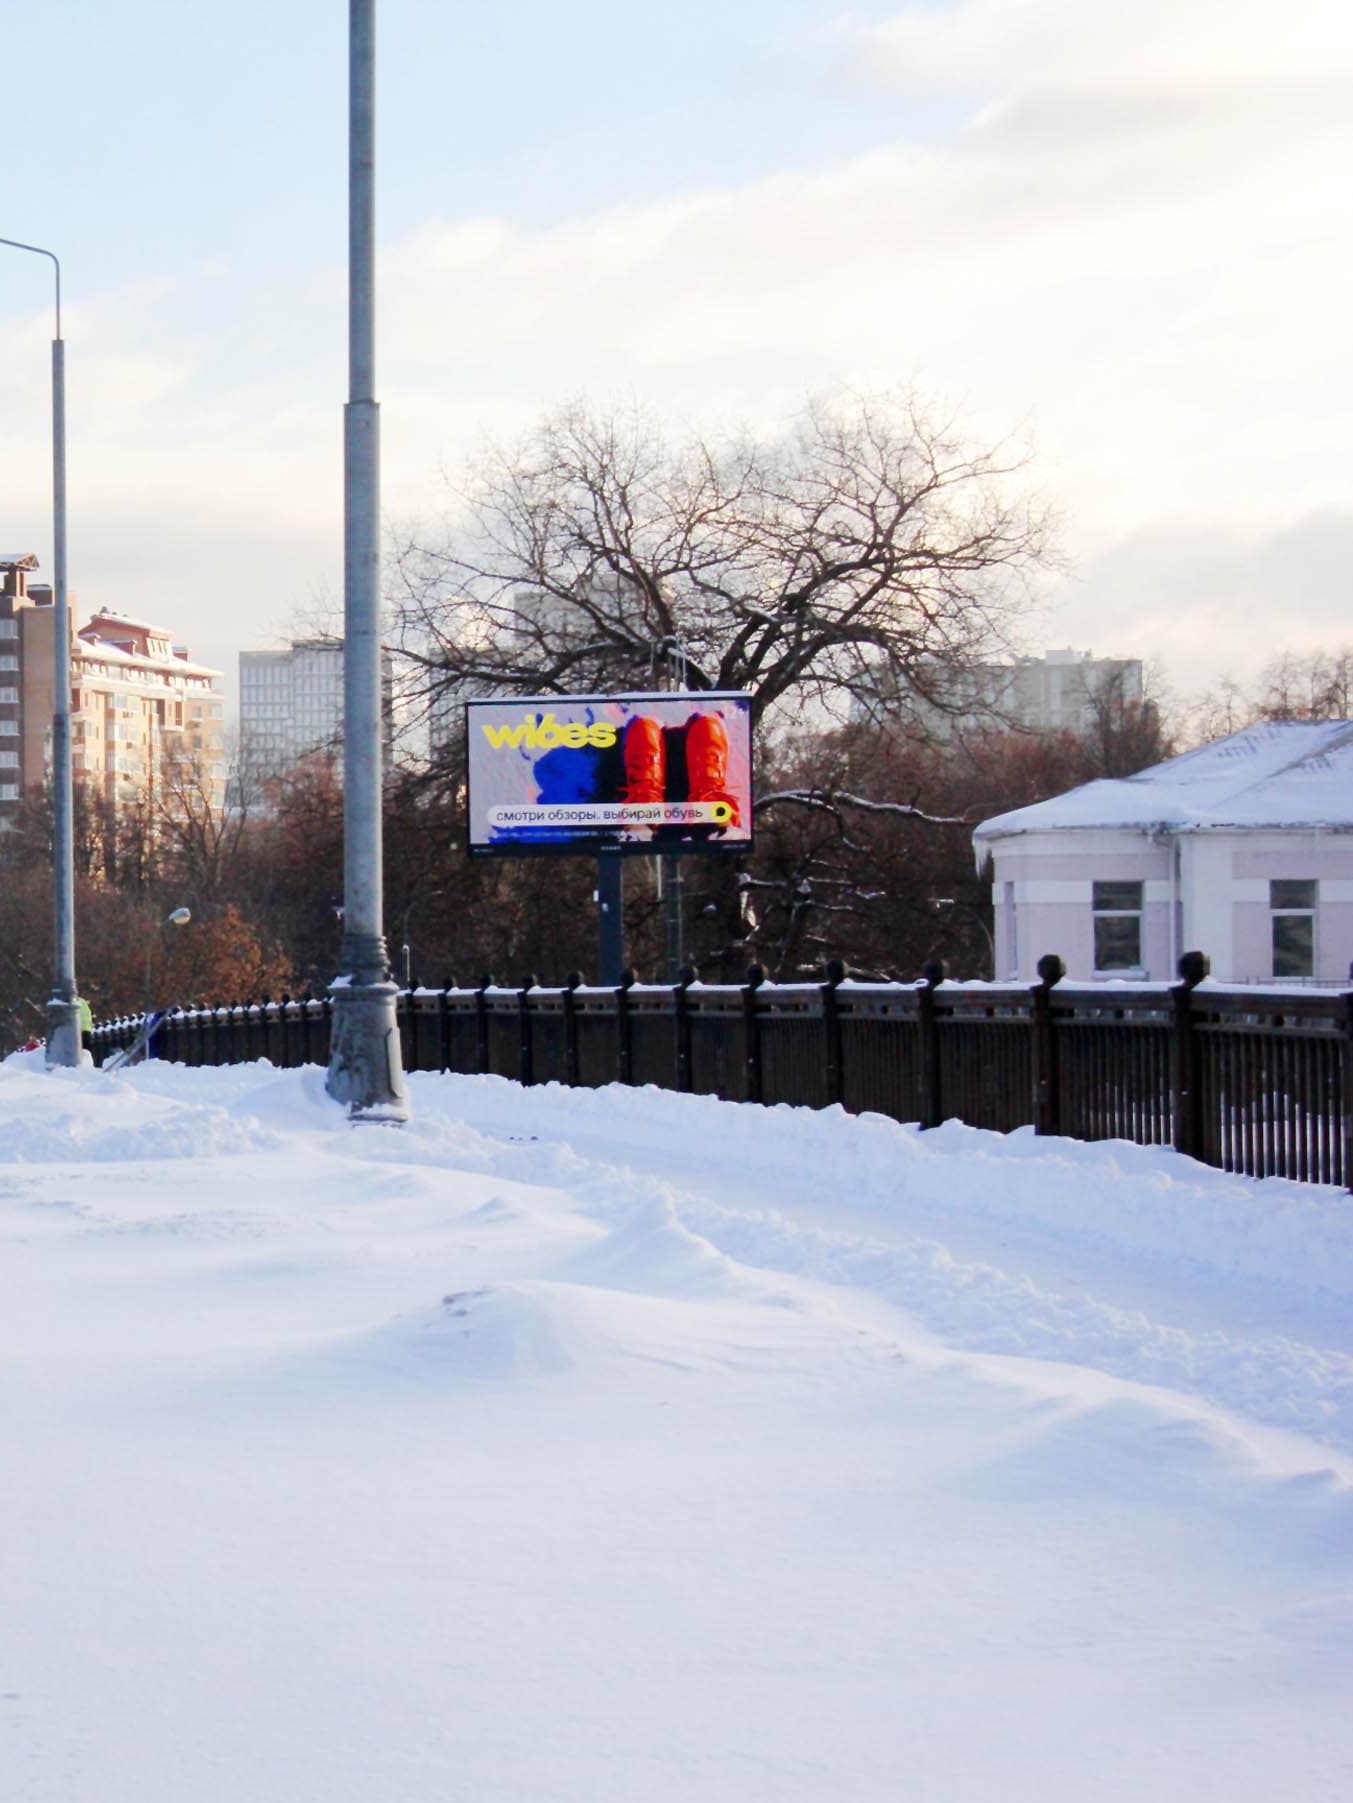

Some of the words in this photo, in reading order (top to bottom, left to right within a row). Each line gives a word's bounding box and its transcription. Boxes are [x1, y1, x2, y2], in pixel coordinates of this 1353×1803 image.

[482, 713, 617, 749] wibes
[496, 810, 545, 824] смотри
[603, 806, 661, 822] выбирай
[664, 805, 703, 820] обувь
